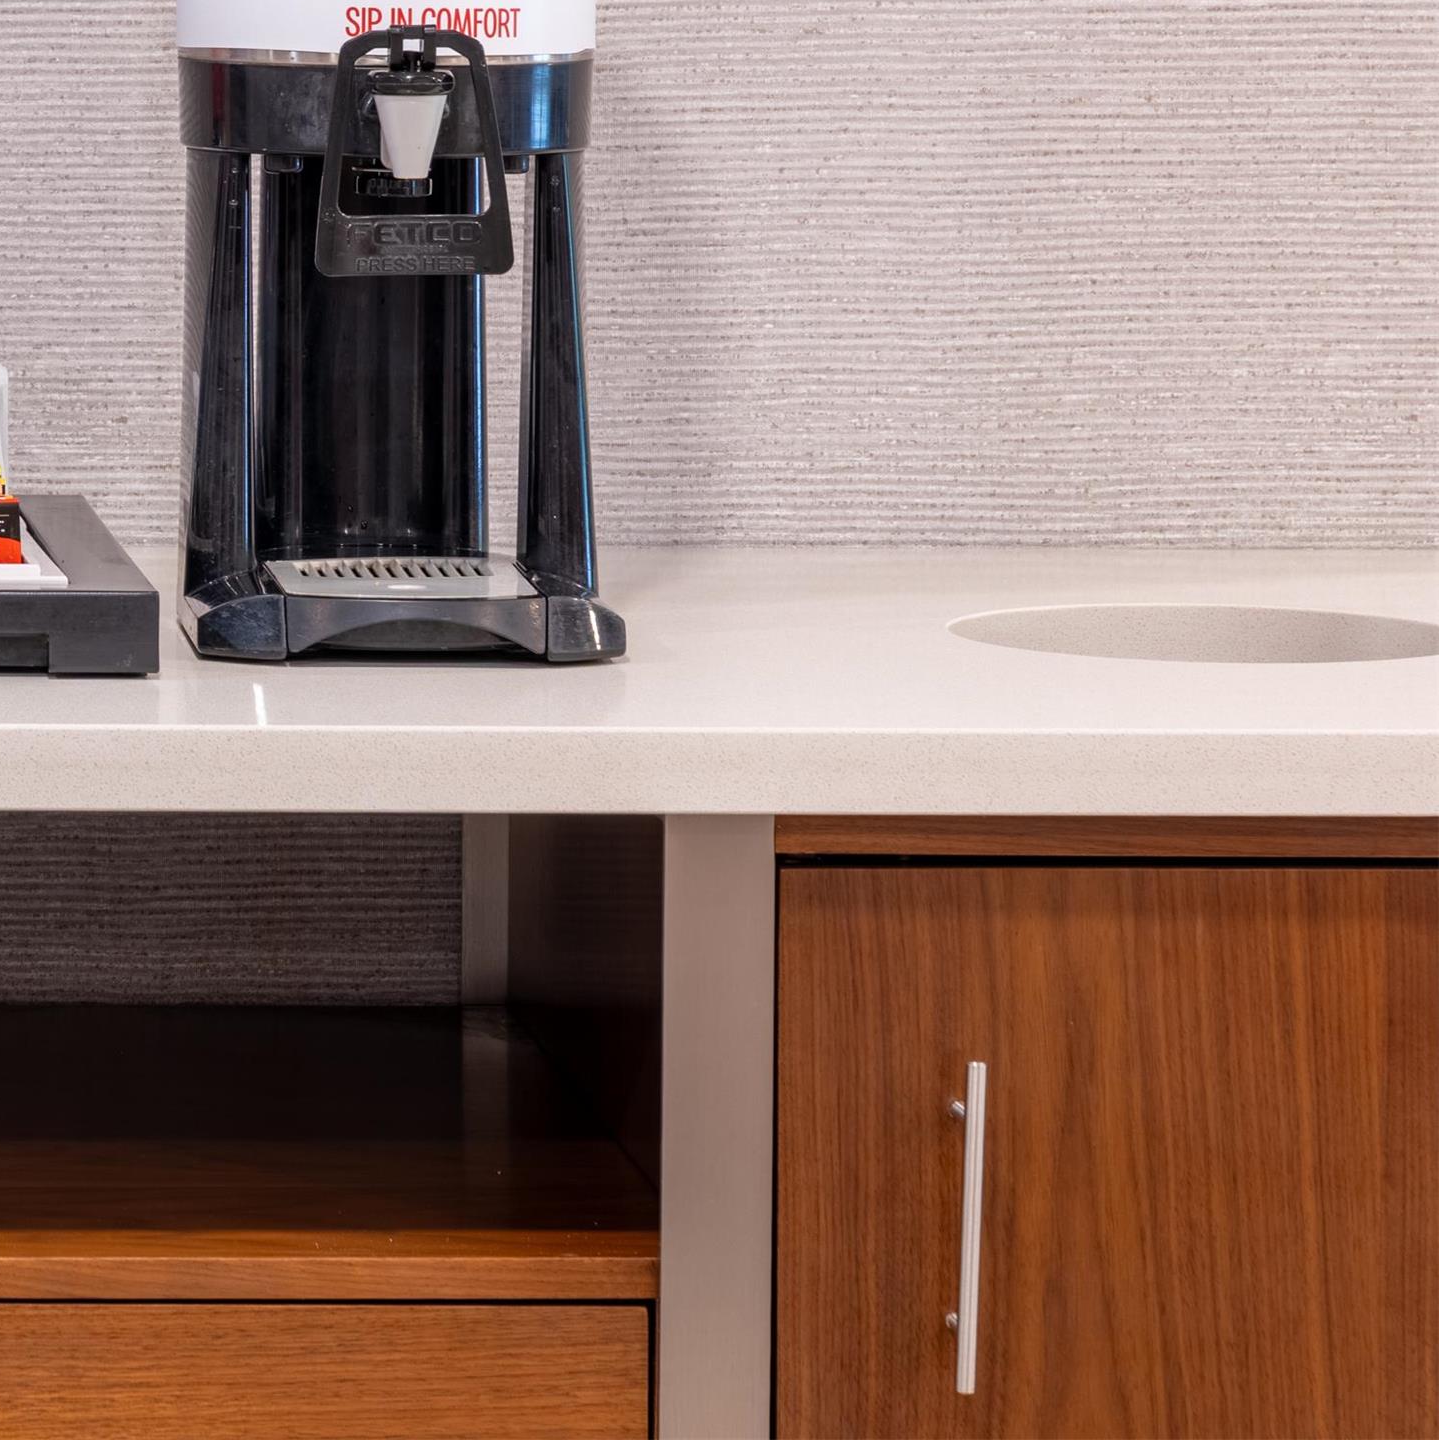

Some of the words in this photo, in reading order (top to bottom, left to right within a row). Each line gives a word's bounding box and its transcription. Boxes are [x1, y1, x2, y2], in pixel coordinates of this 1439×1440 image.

[345, 7, 382, 37] SIP
[391, 7, 412, 26] IN
[422, 7, 521, 38] COMFORT
[347, 220, 482, 245] FETCO
[356, 256, 420, 272] PRESS
[423, 255, 476, 271] HERE
